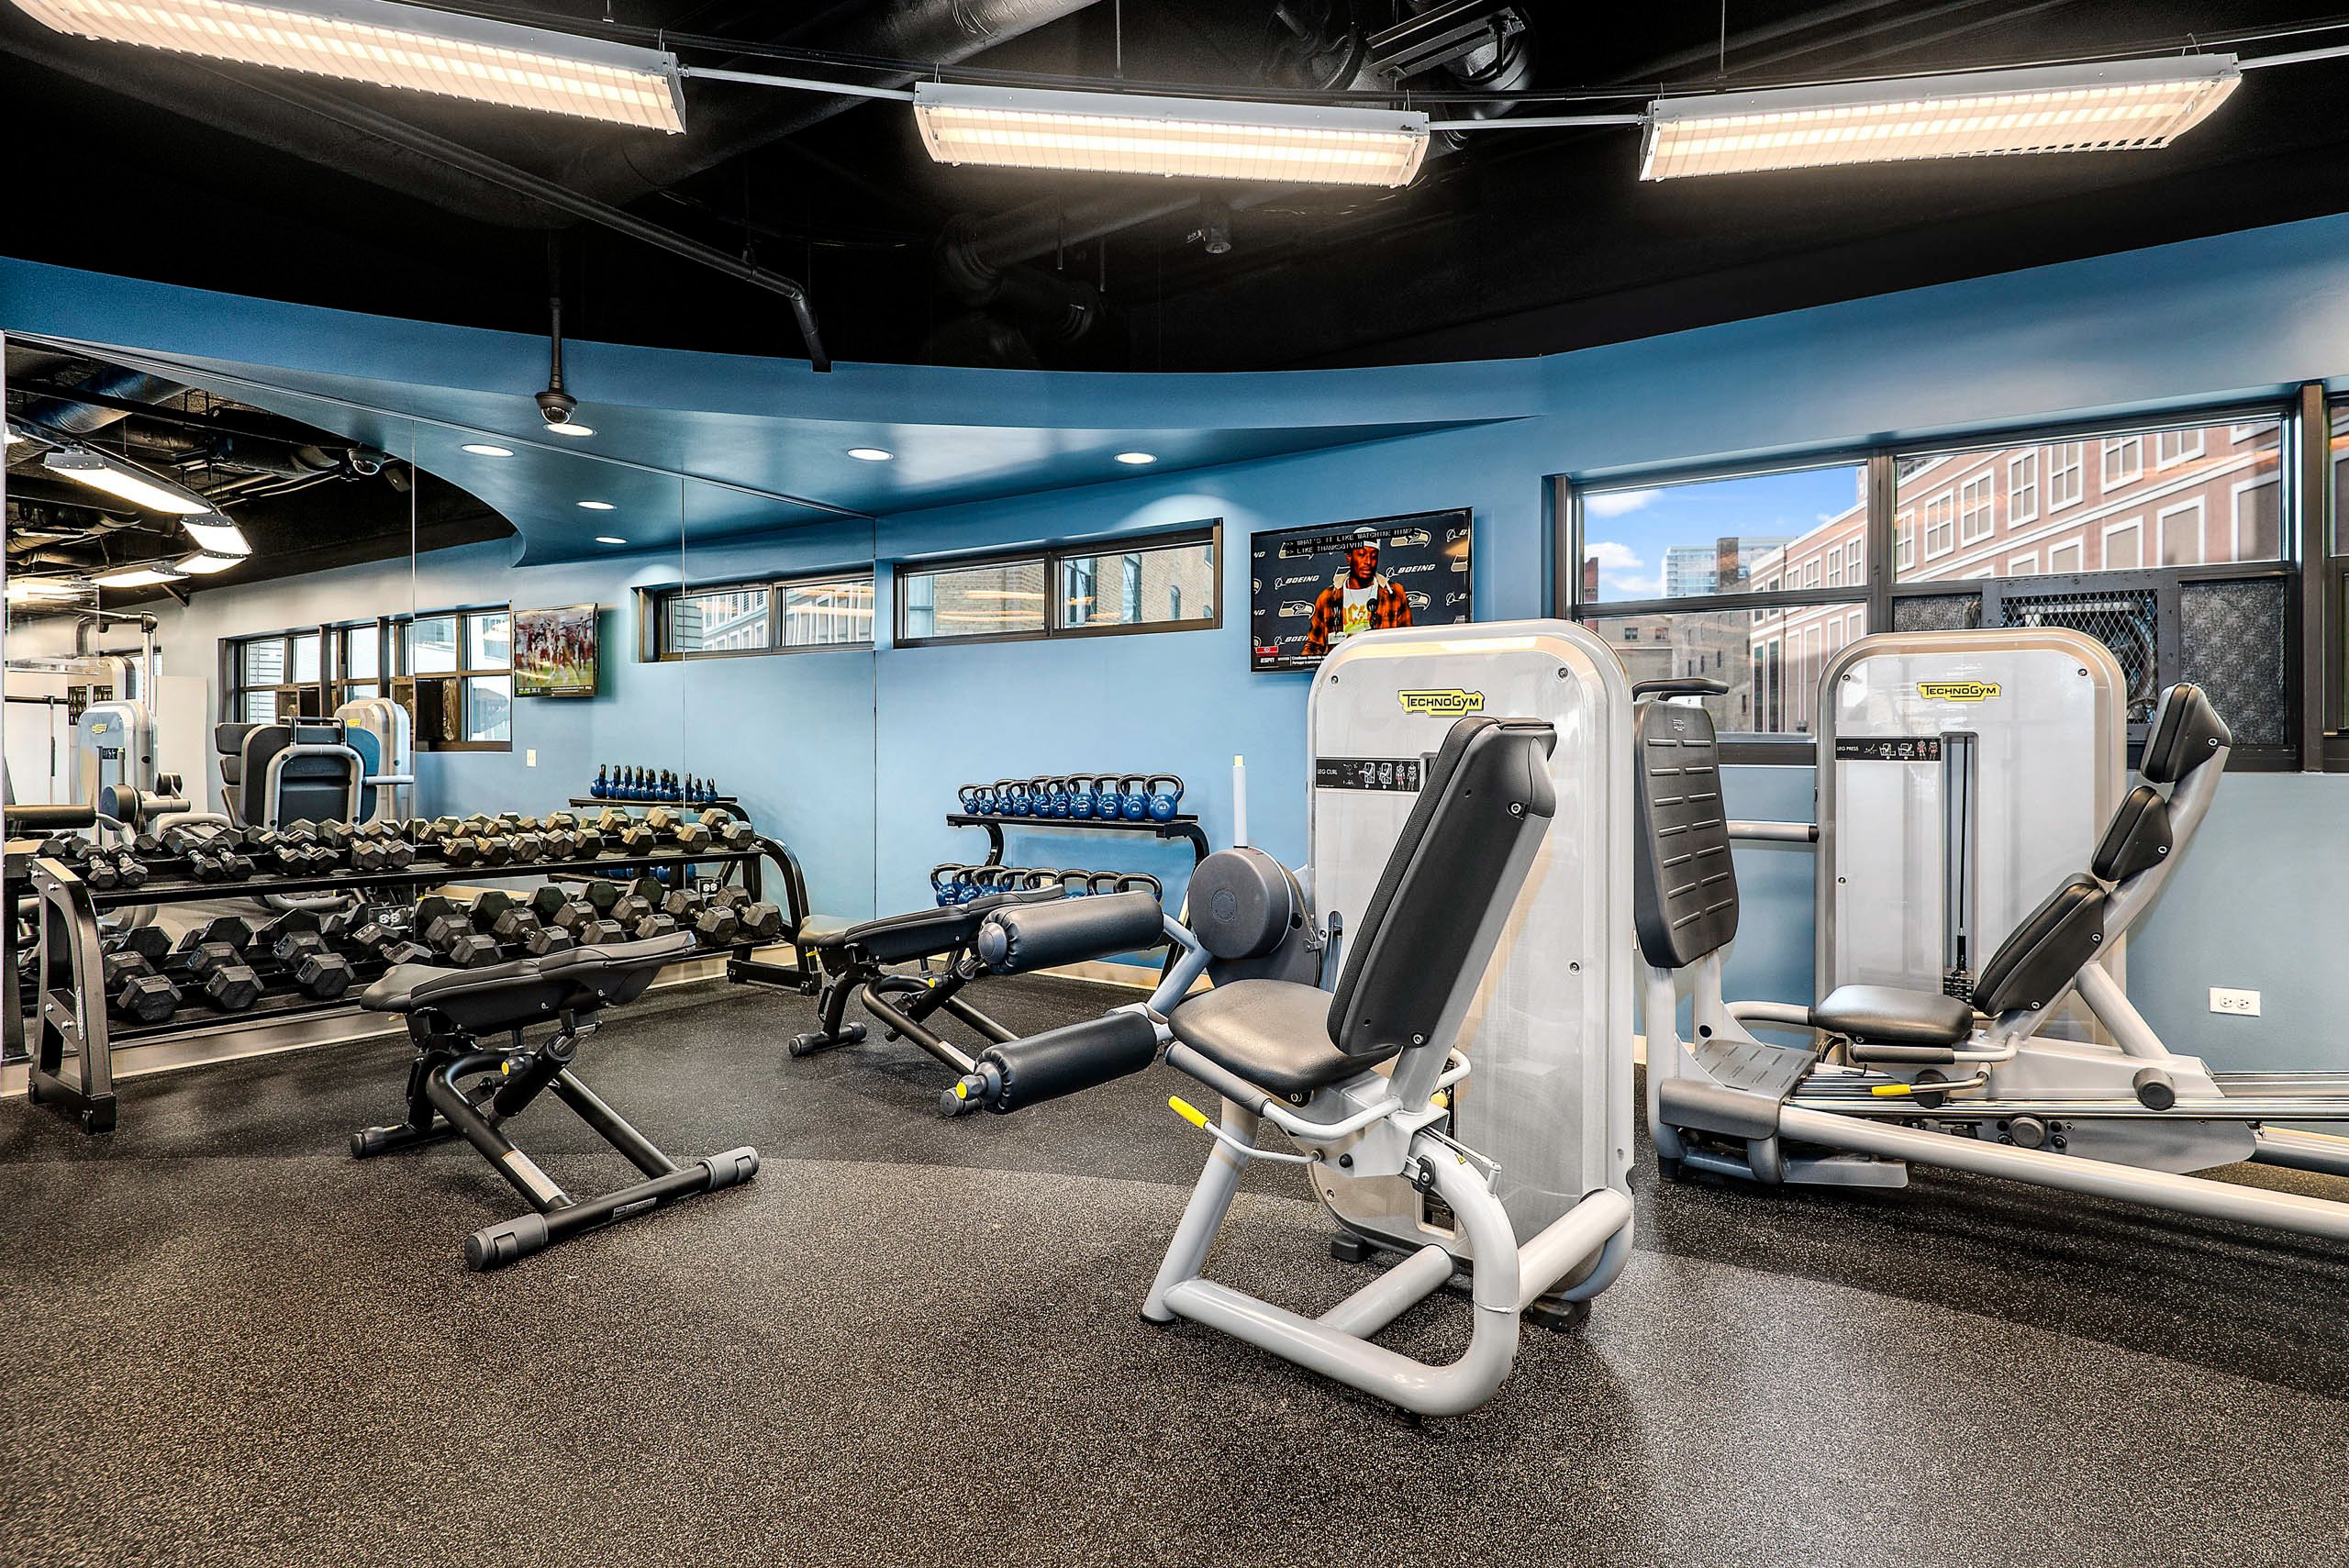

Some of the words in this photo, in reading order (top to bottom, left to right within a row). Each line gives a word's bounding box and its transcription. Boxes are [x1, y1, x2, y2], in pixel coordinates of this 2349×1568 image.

[1397, 564, 1436, 573] BOEING
[1285, 575, 1319, 584] BOEING
[1920, 684, 1997, 698] TECHNOGYM
[1402, 694, 1479, 711] TECHNOGYM
